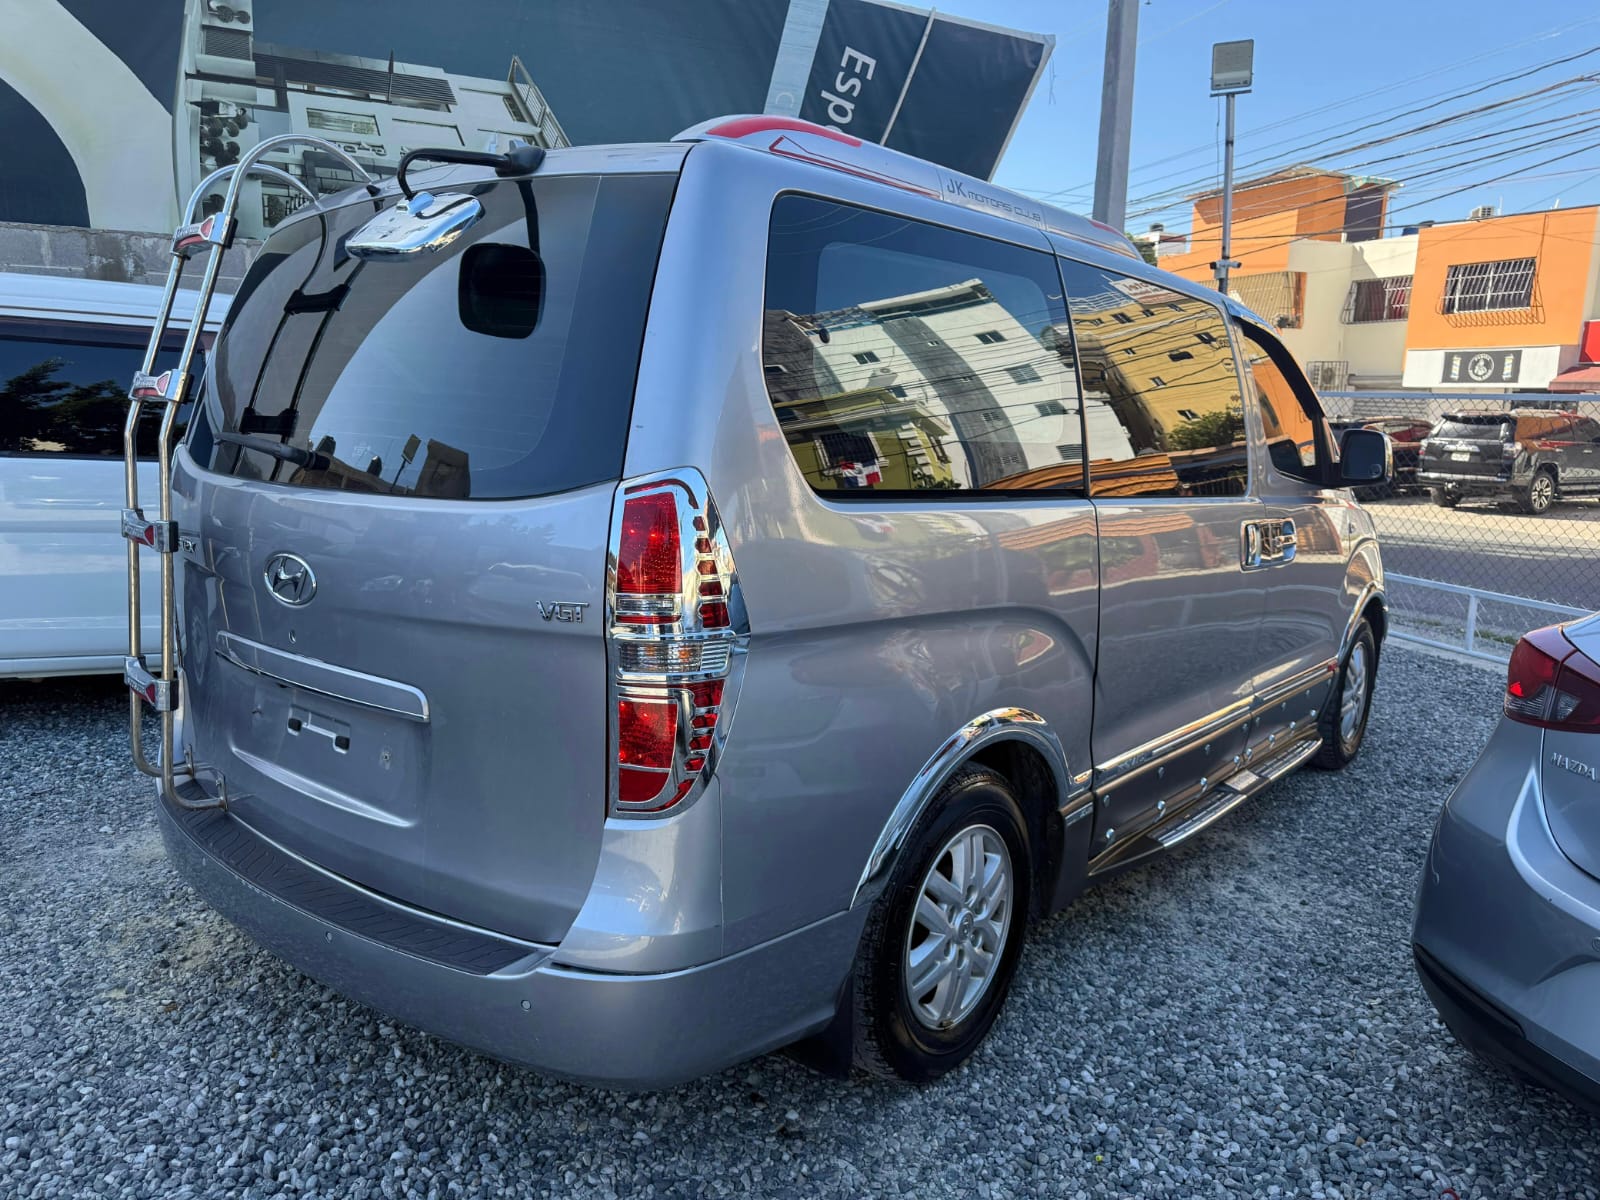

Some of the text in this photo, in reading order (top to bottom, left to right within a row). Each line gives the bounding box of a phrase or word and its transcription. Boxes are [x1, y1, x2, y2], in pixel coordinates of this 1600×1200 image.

[820, 46, 877, 133] Esp
[946, 179, 967, 198] JK
[535, 599, 590, 623] VGT
[1551, 752, 1596, 781] MAZDA
